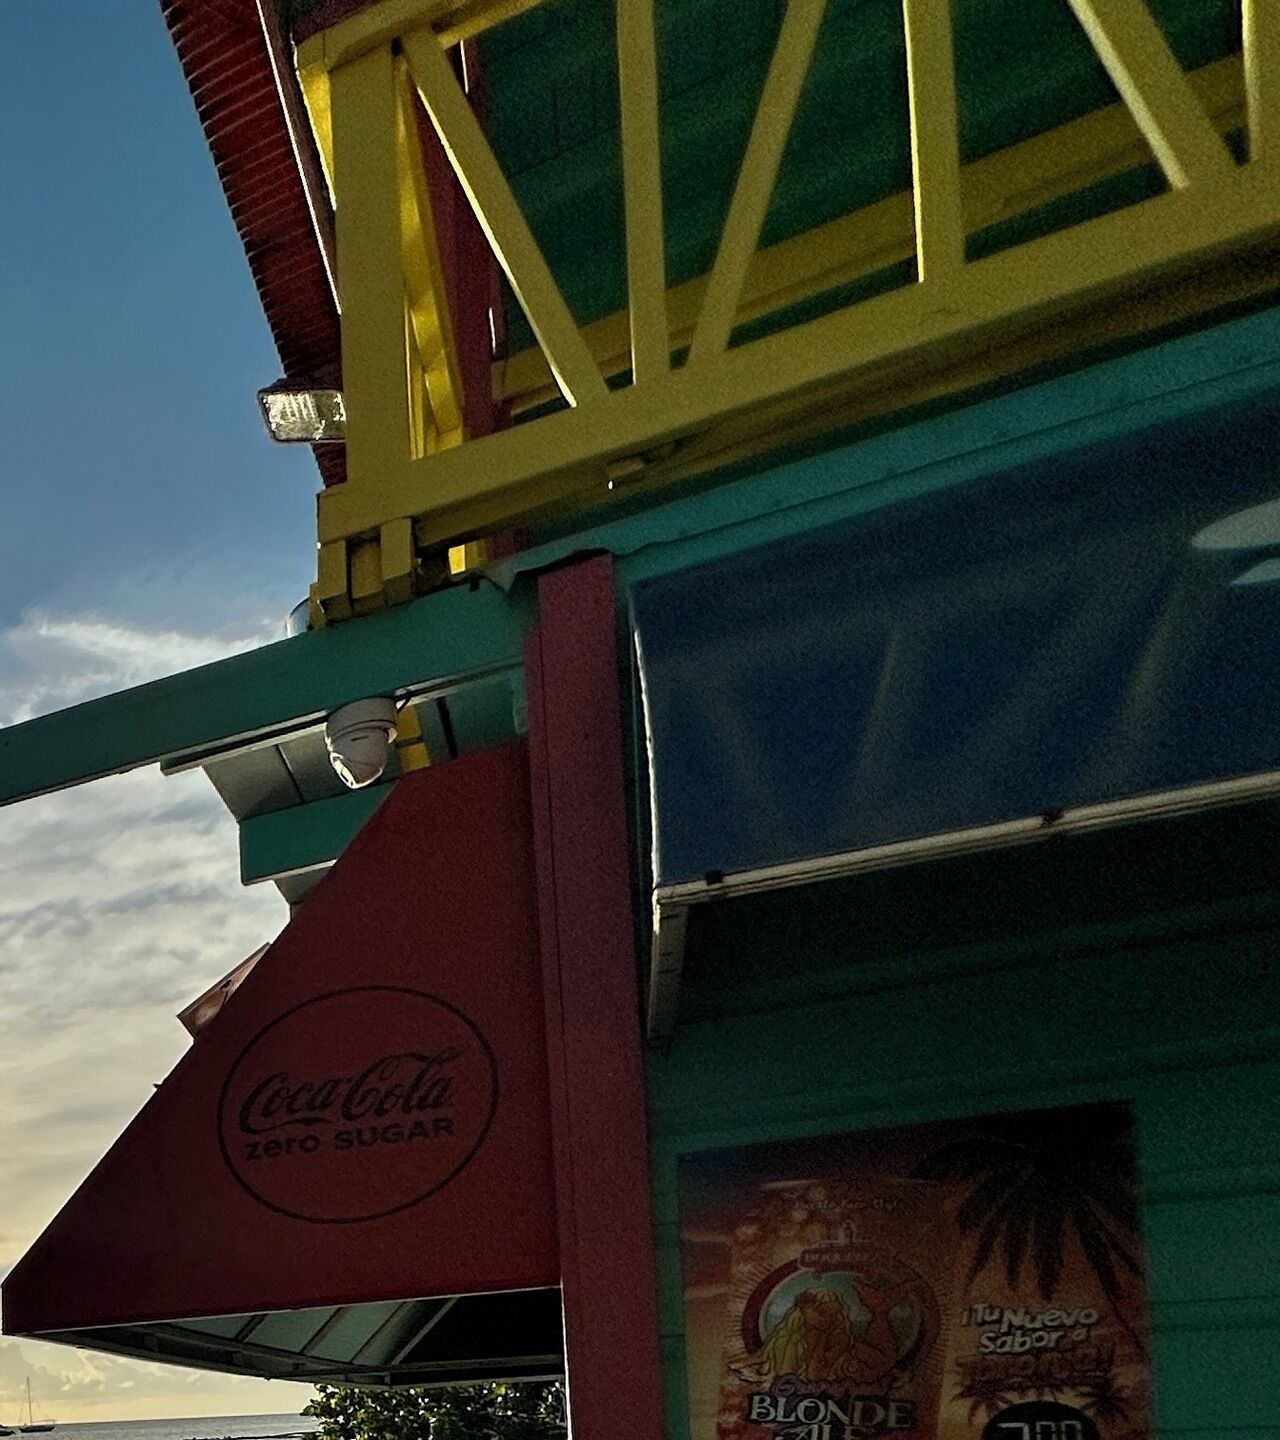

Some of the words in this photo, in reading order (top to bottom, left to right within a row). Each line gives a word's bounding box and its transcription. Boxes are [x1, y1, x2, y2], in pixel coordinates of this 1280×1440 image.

[238, 1048, 464, 1135] Coca-Cola
[334, 1117, 455, 1151] SUGAR
[979, 1331, 1064, 1354] Sabor
[749, 1395, 912, 1429] BLONDE
